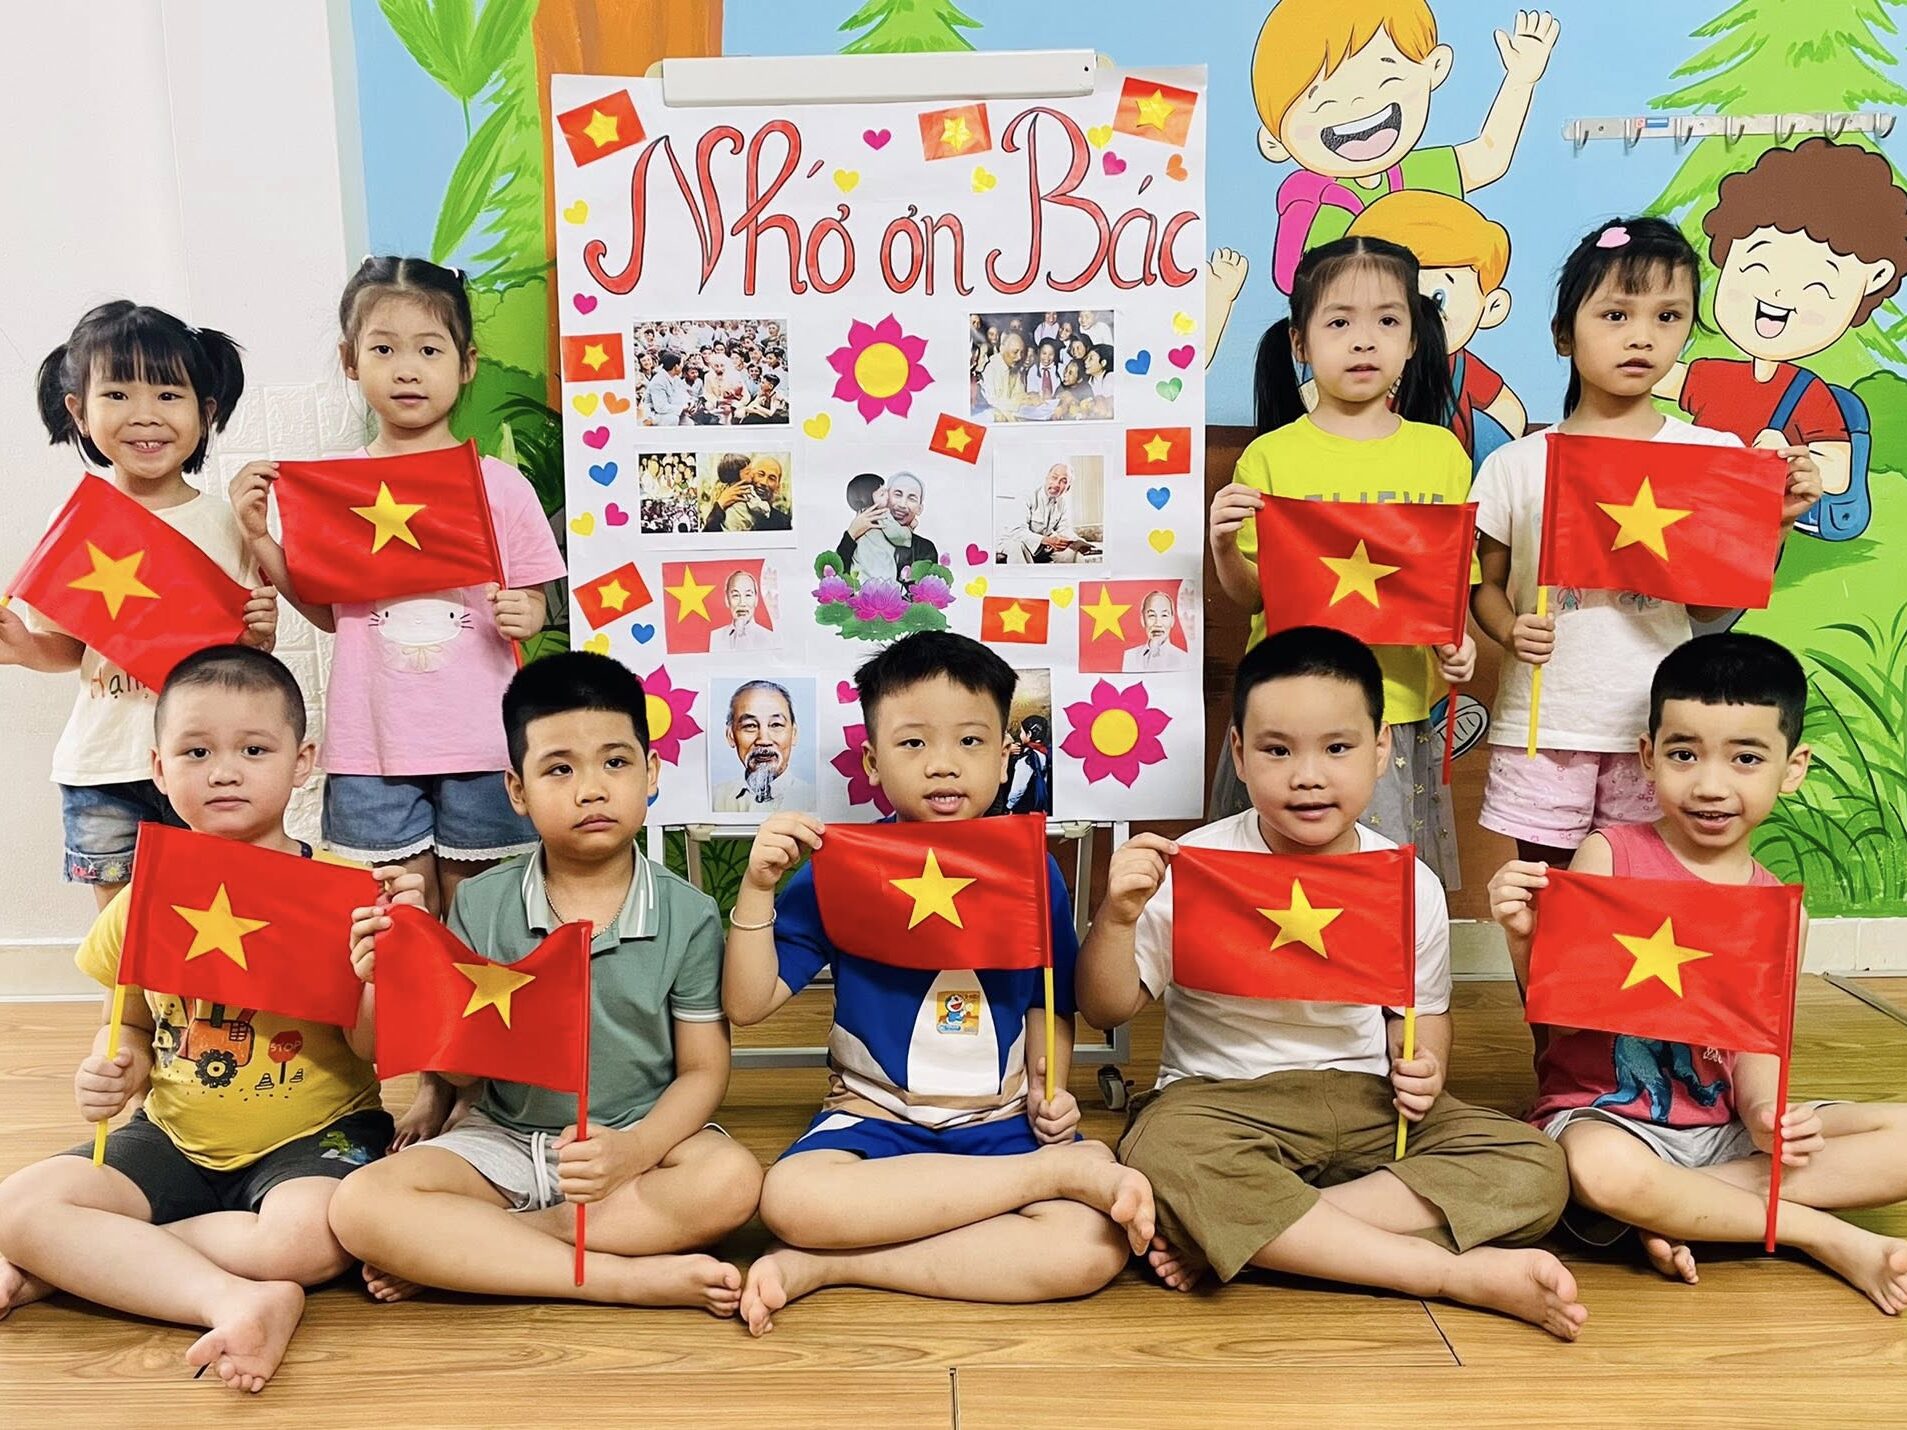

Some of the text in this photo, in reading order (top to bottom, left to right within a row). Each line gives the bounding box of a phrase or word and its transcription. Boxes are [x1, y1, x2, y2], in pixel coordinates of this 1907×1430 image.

[583, 106, 1200, 296] Nhớ ơn Bác
[270, 1040, 302, 1053] STOP
